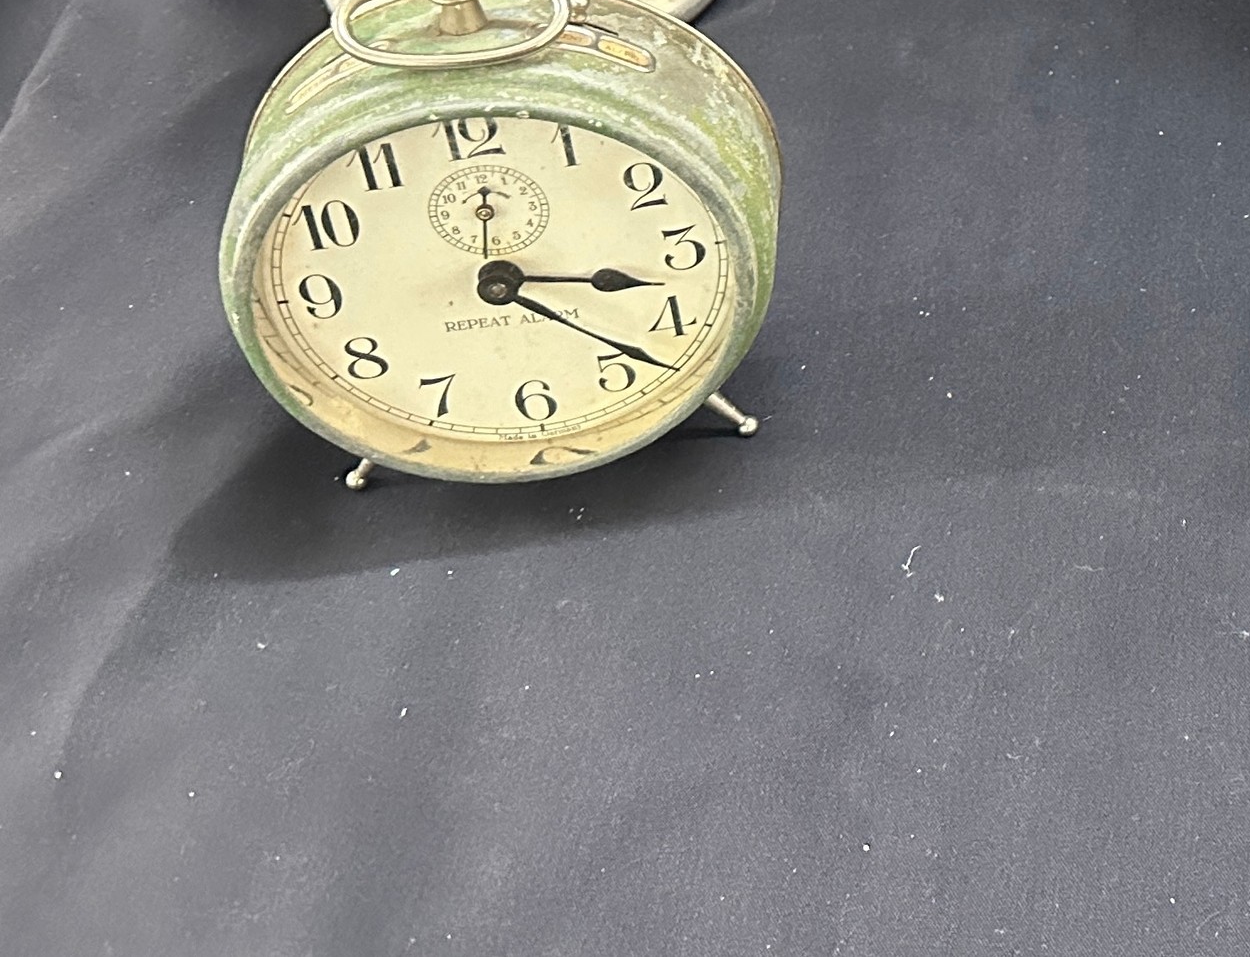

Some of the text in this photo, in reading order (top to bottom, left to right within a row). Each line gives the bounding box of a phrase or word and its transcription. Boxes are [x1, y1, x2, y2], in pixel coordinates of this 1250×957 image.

[432, 117, 507, 162] 12
[551, 124, 582, 167] 1
[346, 143, 405, 192] 11
[475, 174, 488, 185] 12
[456, 181, 467, 191] 11
[501, 177, 508, 186] 1
[519, 186, 528, 196] 2
[623, 162, 669, 211] 2
[442, 193, 457, 204] 10
[528, 201, 537, 211] 3
[292, 199, 360, 252] 10
[440, 210, 450, 220] 9
[526, 218, 534, 227] 4
[452, 226, 461, 236] 8
[470, 235, 478, 244] 7
[491, 236, 502, 246] 6
[512, 231, 521, 241] 5
[661, 224, 706, 270] 3
[299, 274, 342, 319] 9
[445, 308, 580, 333] REPEAT ALM
[648, 295, 697, 337] 4
[344, 337, 389, 379] 8
[597, 351, 636, 392] 5
[418, 374, 456, 418] 7
[515, 380, 557, 421] 6
